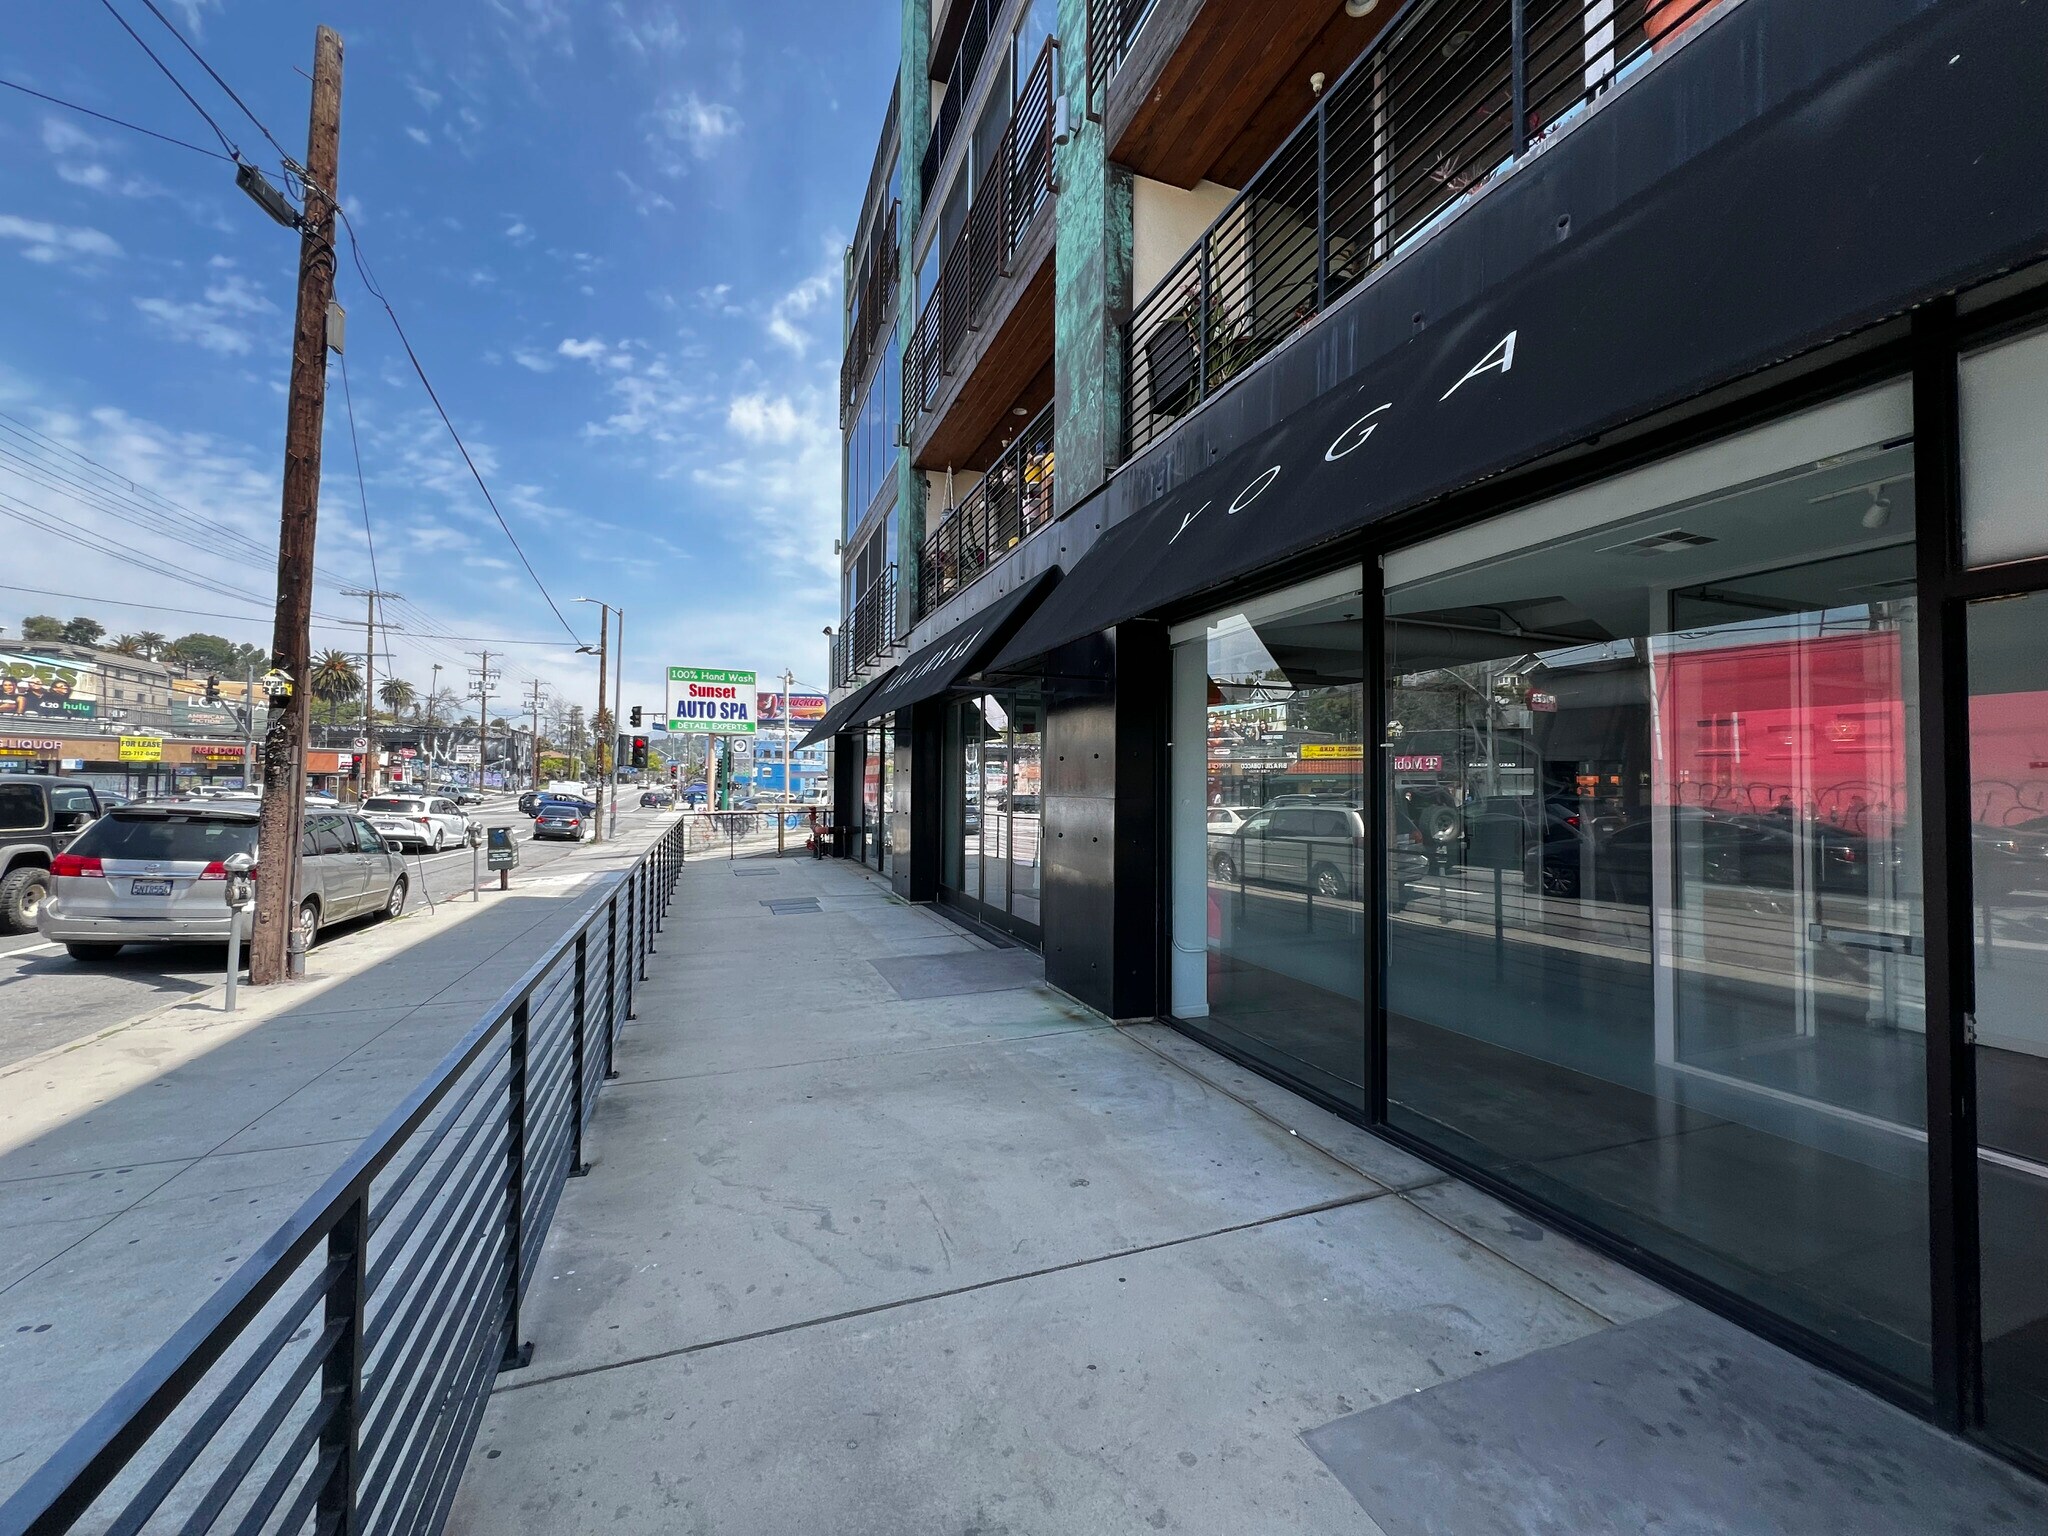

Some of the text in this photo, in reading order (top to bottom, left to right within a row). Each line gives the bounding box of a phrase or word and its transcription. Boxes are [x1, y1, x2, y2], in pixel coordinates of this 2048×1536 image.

[1168, 329, 1518, 546] YOGA
[671, 671, 754, 683] 100% Hand Wash
[689, 683, 737, 699] Sunset
[63, 701, 90, 711] hulu
[676, 700, 749, 720] AUTO SPA
[677, 722, 749, 731] DETAIL EXPERTS
[8, 739, 63, 750] LIQUOR
[137, 740, 162, 748] LEASE
